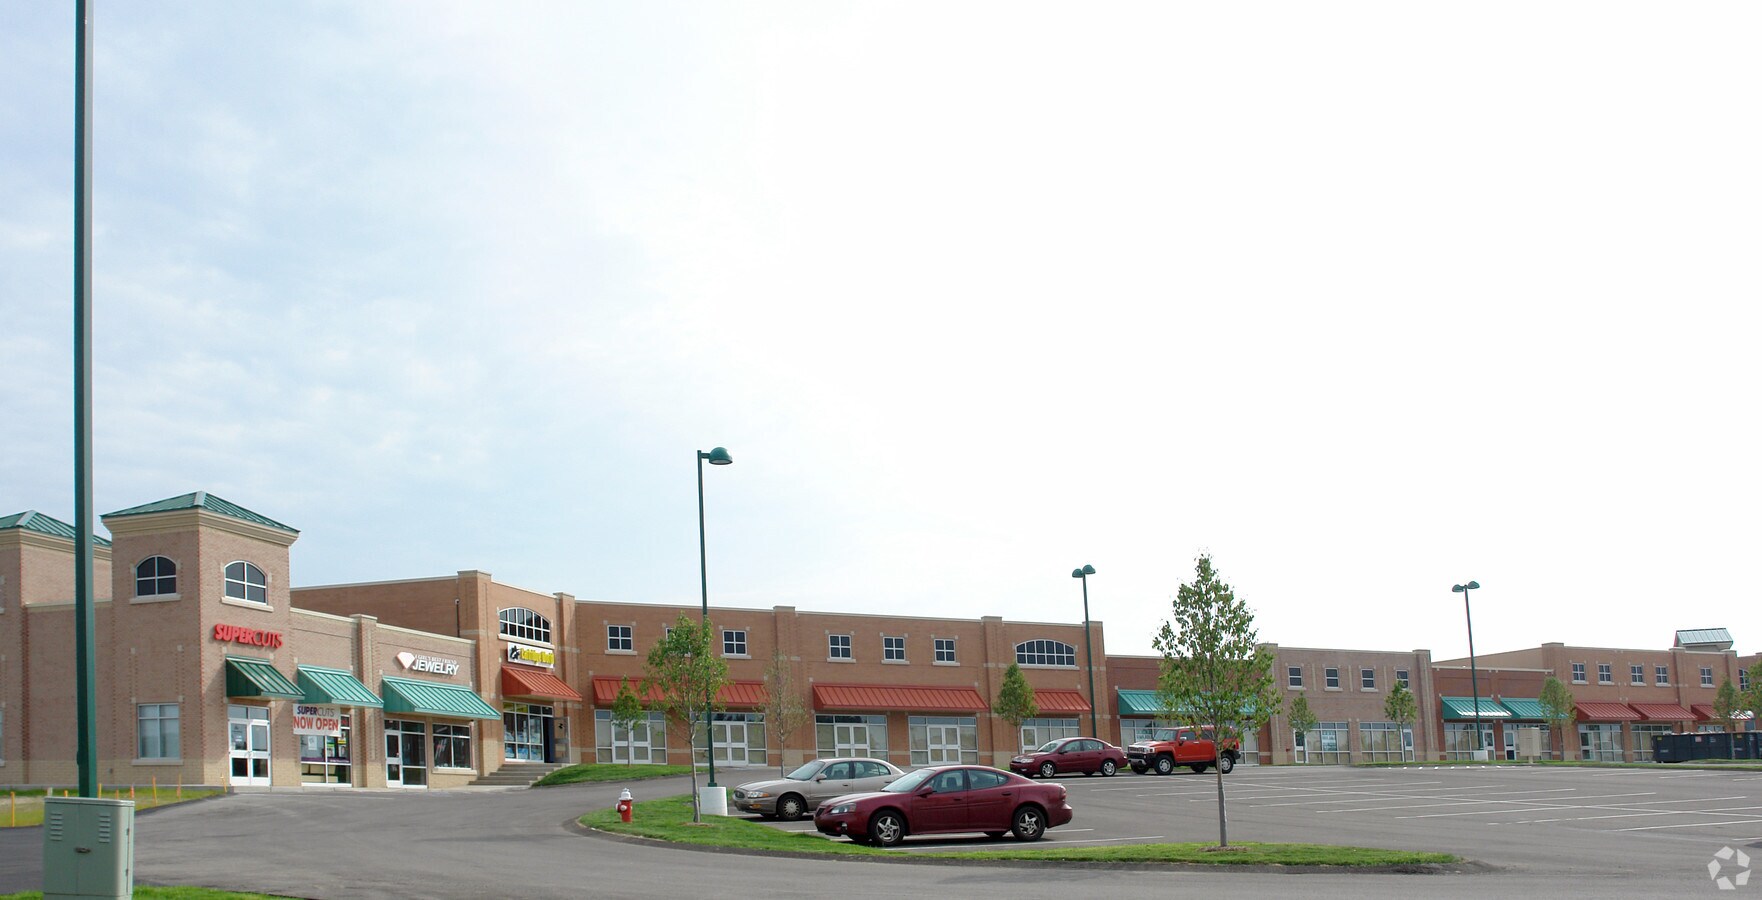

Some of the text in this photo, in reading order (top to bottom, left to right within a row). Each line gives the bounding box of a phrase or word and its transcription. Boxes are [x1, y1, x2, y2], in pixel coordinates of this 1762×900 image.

[213, 623, 283, 649] SUPERCUTS
[412, 659, 460, 675] JEWELRY
[297, 706, 335, 717] SUPERCUTS
[293, 716, 339, 731] NOW OPEN
